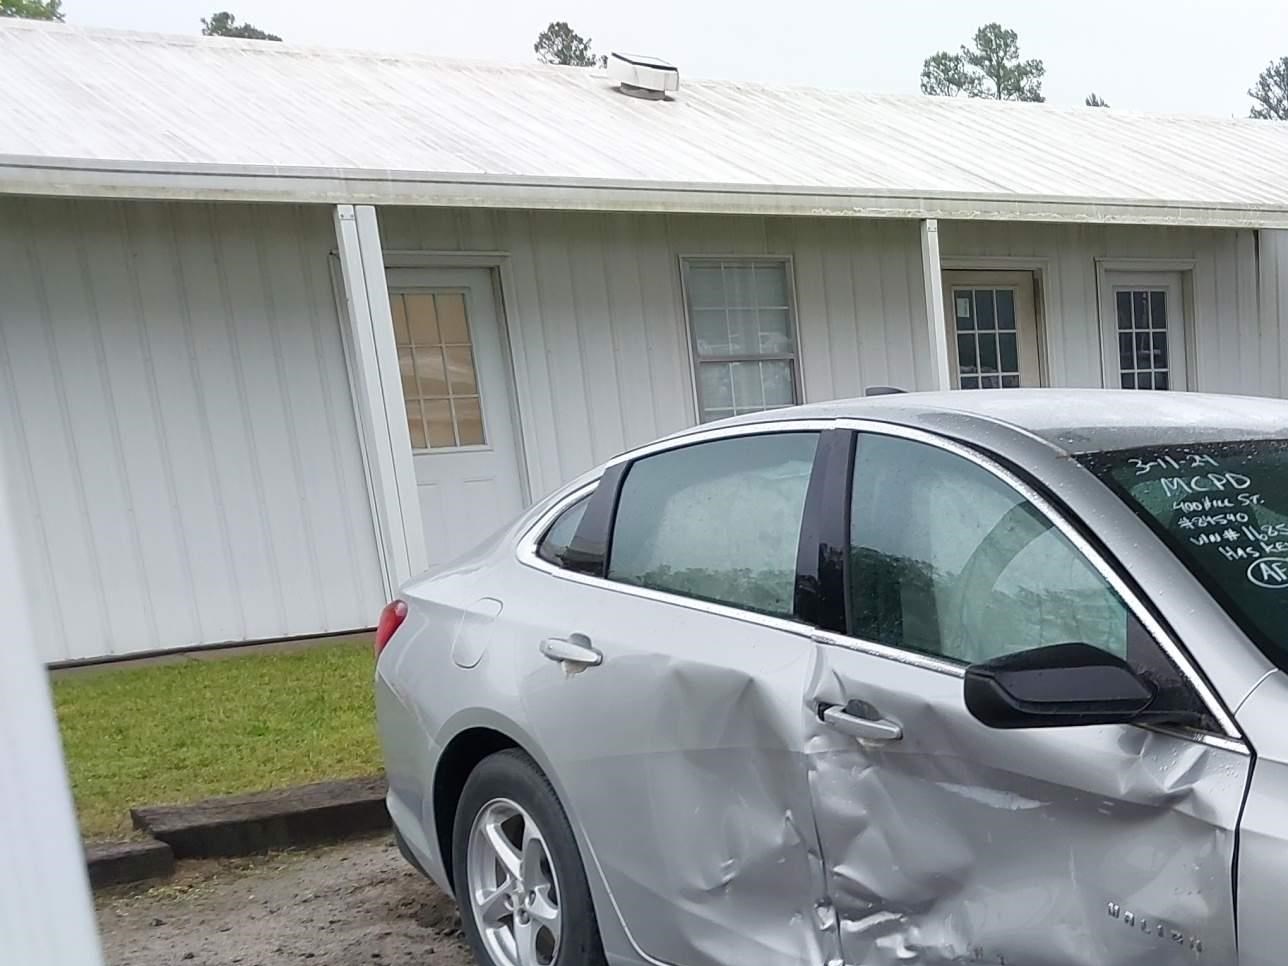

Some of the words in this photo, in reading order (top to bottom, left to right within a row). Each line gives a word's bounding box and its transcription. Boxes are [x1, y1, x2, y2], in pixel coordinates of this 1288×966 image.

[1128, 454, 1219, 475] 3-11-24
[1160, 472, 1251, 497] MCPD
[1218, 545, 1260, 560] HAS
[1259, 561, 1288, 582] AF
